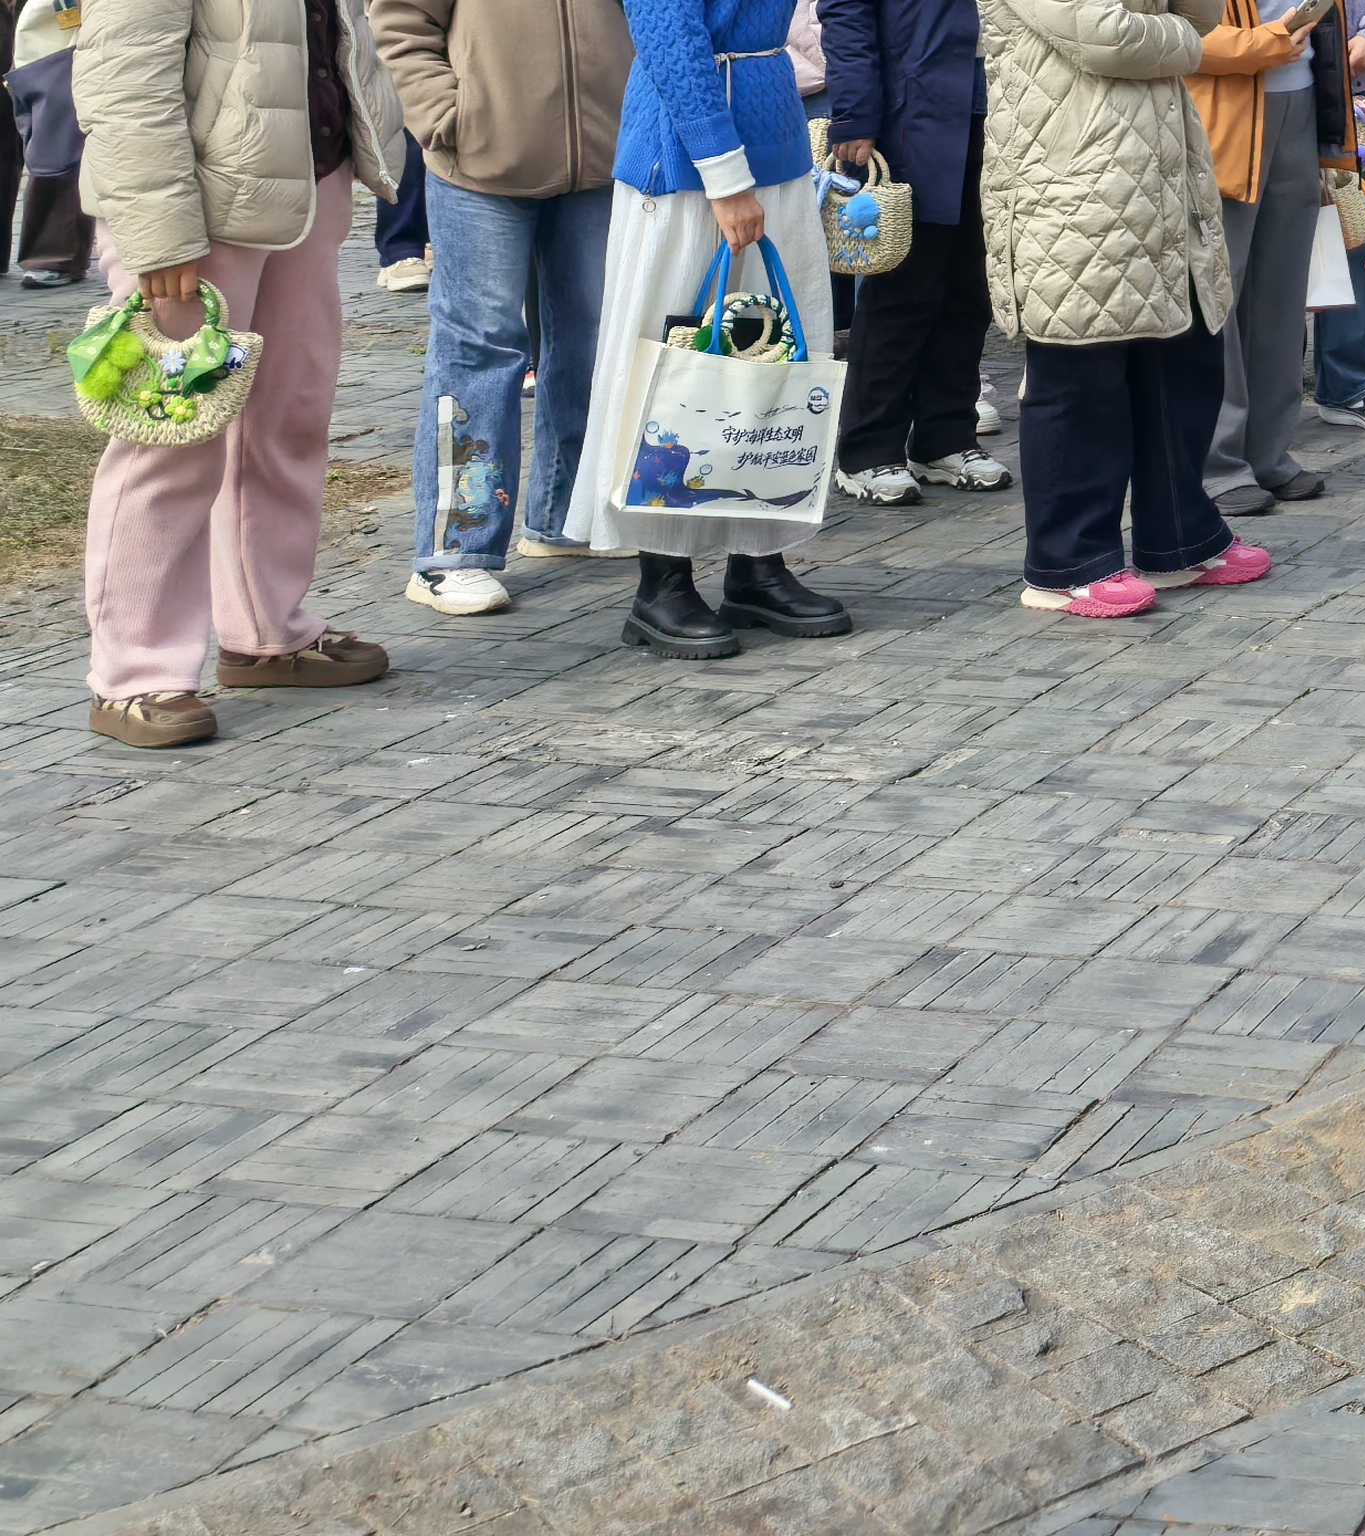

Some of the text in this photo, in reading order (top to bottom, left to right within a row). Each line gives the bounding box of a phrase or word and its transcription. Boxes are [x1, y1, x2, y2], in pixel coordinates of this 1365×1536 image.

[722, 425, 804, 446] 守护海洋生态文明
